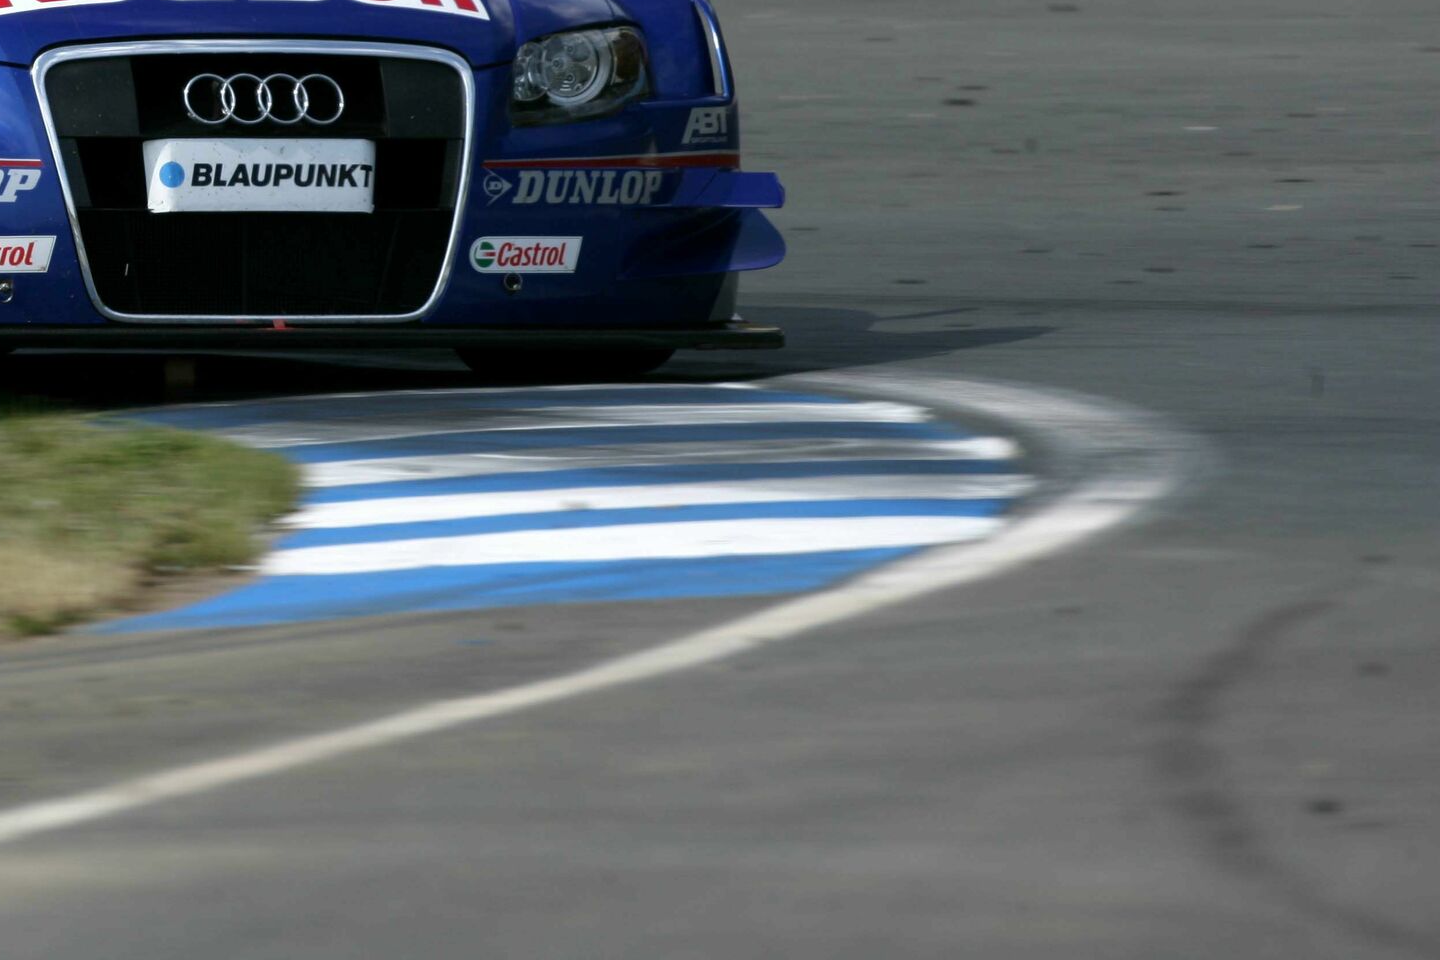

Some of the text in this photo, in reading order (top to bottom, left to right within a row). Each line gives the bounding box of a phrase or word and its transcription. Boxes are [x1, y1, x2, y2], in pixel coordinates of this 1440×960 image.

[681, 107, 728, 144] ABT
[191, 162, 373, 188] BLAUPUNKT
[512, 170, 663, 204] DUNLOP
[497, 242, 567, 266] Castrol
